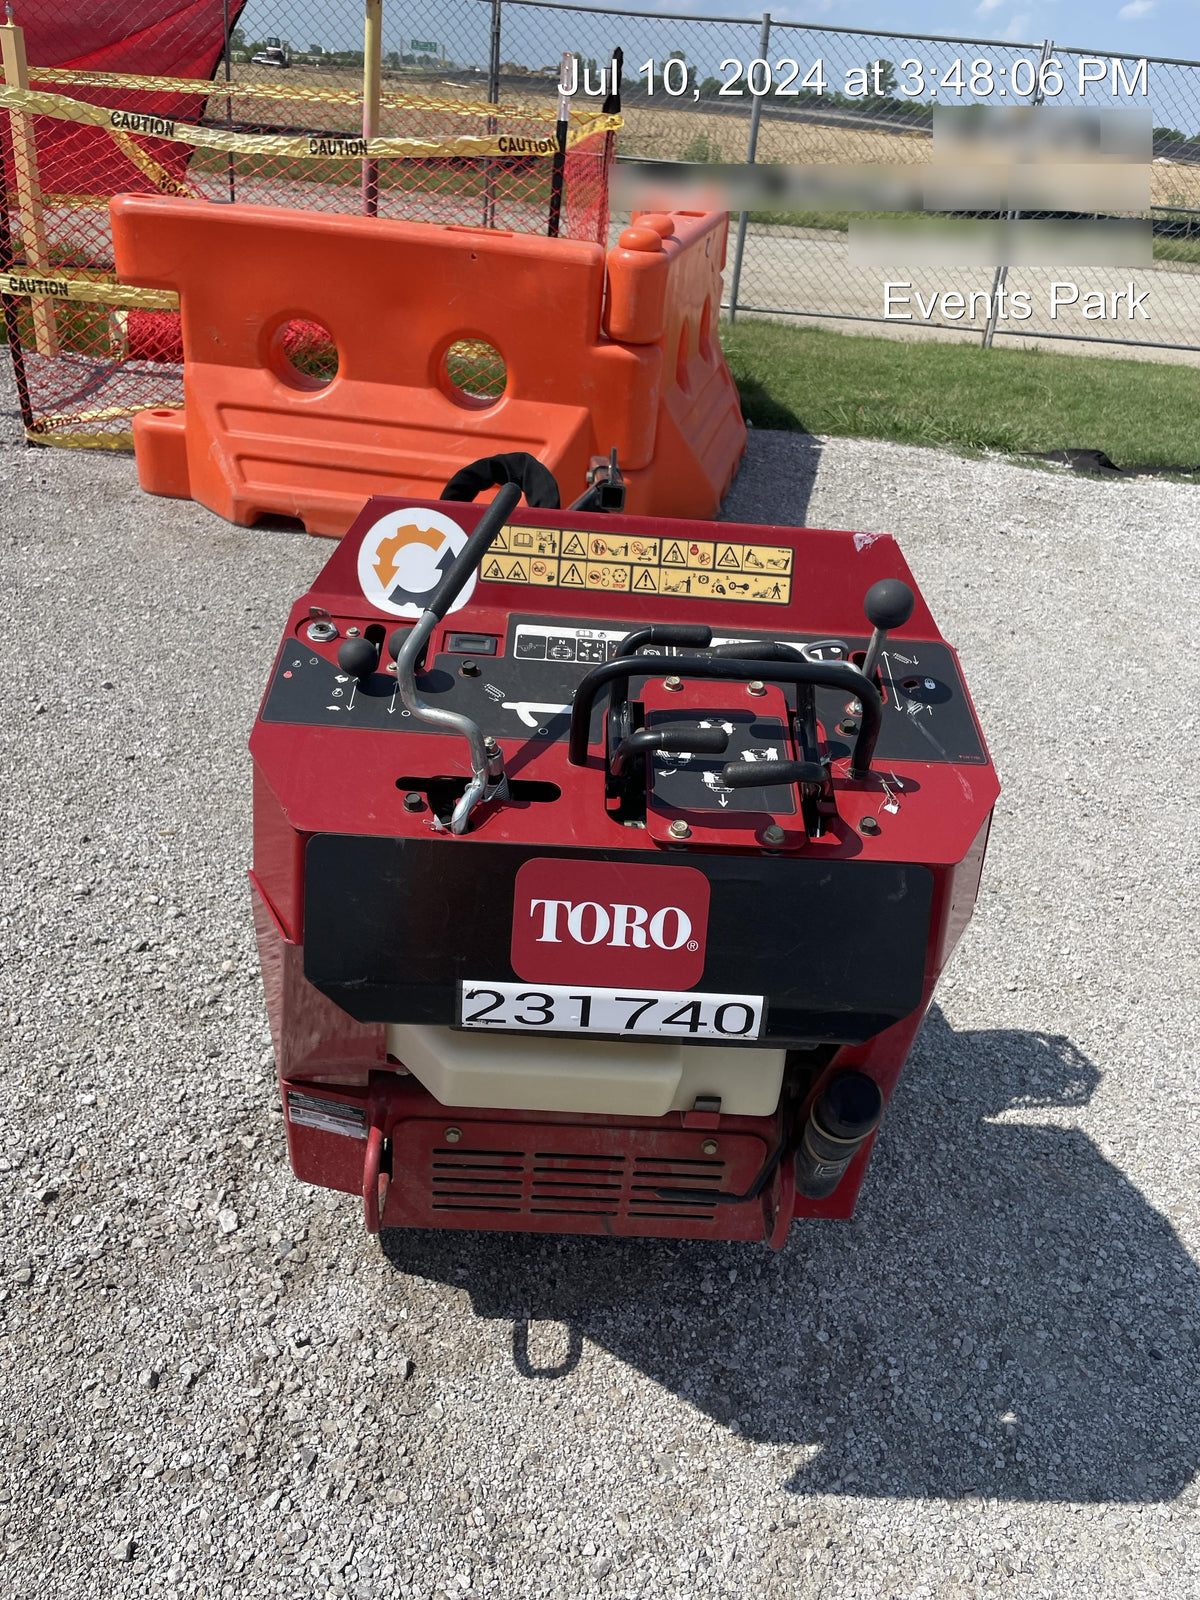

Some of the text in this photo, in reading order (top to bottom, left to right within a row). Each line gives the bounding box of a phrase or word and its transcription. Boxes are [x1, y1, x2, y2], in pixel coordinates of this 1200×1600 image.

[110, 111, 175, 137] CAUTION
[309, 139, 368, 156] CAUTION
[498, 137, 558, 153] CAUTION
[9, 277, 69, 296] CAUTION
[530, 898, 692, 950] TORO
[464, 989, 756, 1036] 231740
